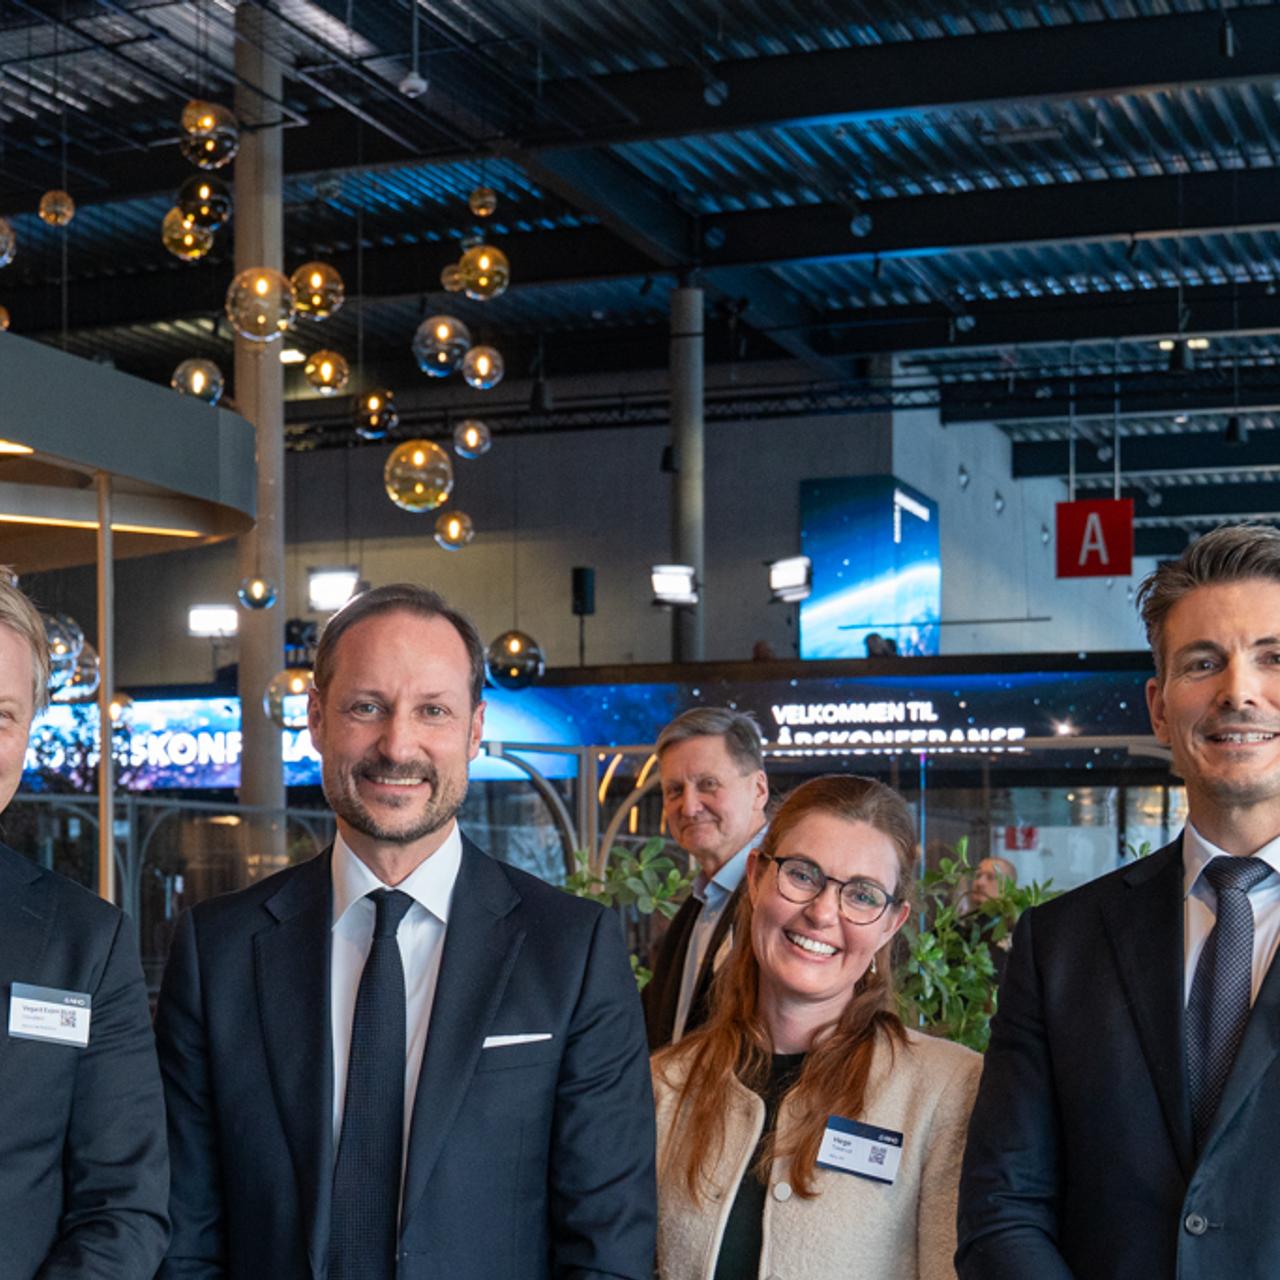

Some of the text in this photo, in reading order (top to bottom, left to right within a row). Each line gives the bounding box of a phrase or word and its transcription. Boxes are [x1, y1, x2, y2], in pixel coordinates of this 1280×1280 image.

[1078, 512, 1108, 566] A
[771, 702, 939, 725] VELKOMMEN TIL
